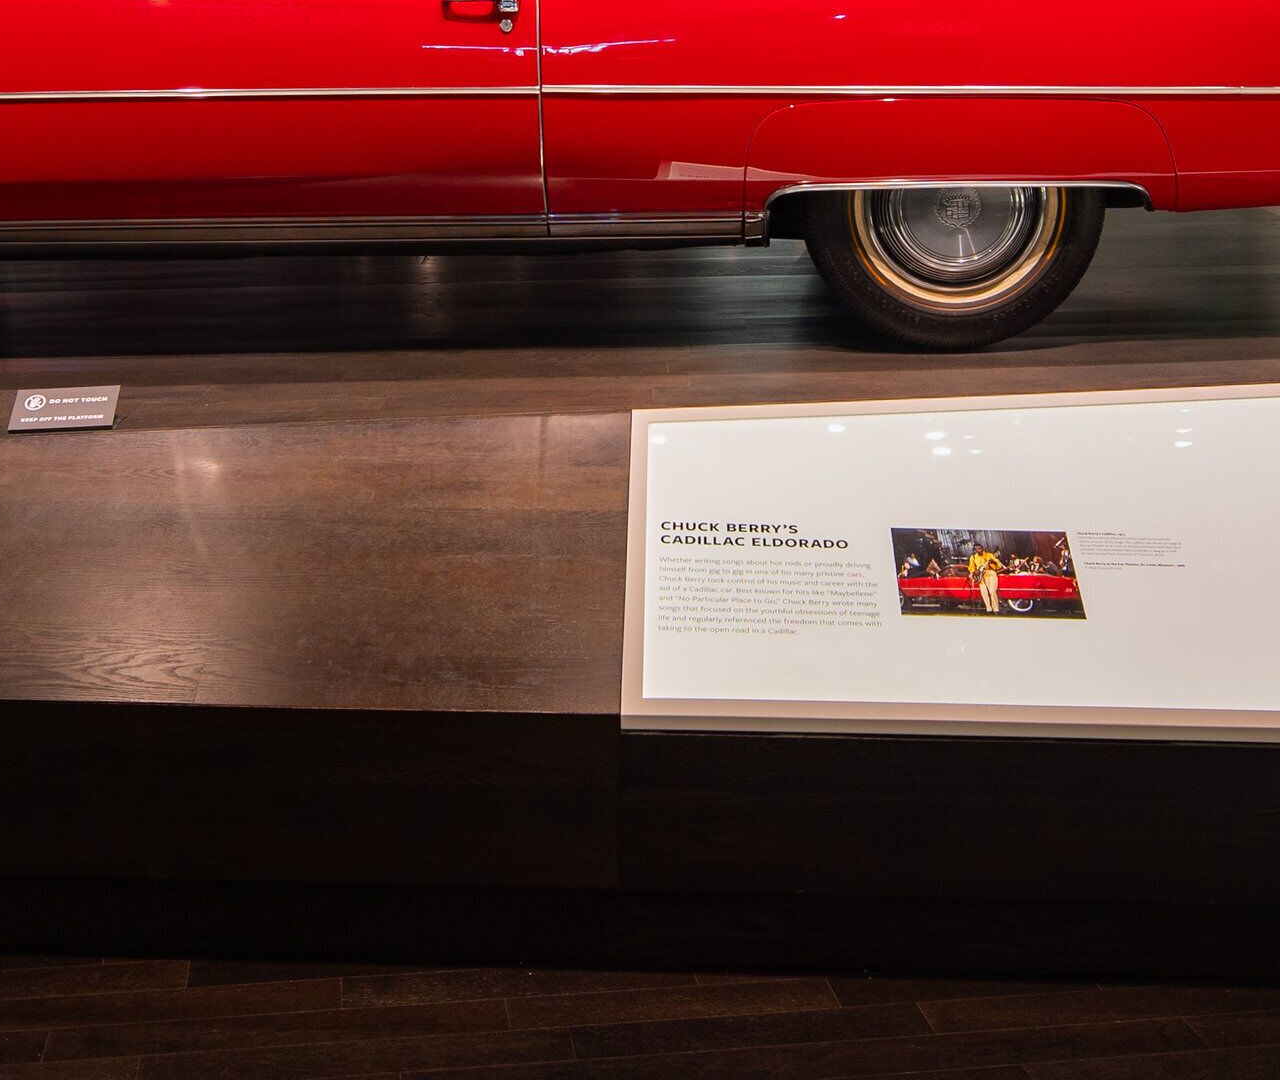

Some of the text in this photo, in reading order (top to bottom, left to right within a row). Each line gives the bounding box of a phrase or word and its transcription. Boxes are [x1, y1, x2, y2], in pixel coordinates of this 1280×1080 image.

[661, 521, 799, 534] CHUCK BERRY’S
[661, 535, 849, 549] CADILLAC ELDORADO
[659, 625, 682, 633] taking
